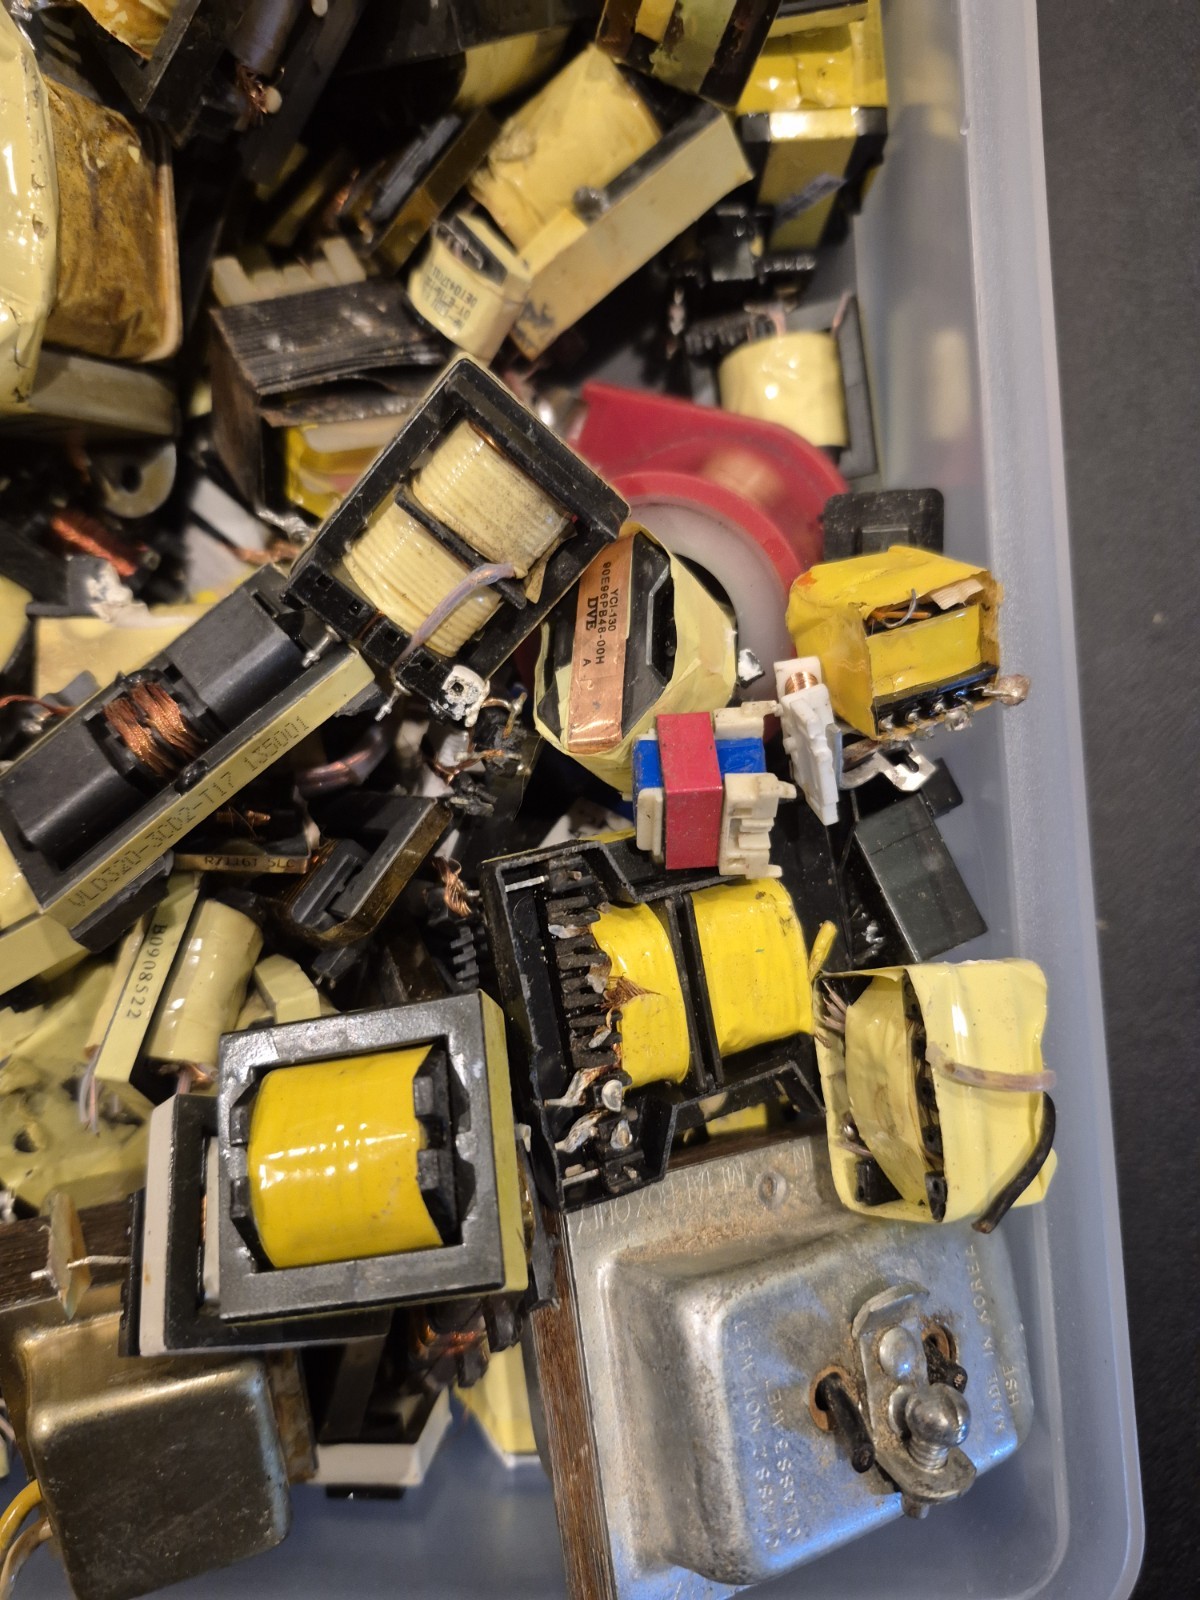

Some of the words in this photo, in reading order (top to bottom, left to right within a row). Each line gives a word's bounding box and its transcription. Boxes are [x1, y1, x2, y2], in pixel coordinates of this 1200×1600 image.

[586, 596, 599, 631] DVE
[608, 588, 619, 632] YCI-130
[583, 658, 592, 667] A
[244, 716, 310, 772] 135001
[126, 924, 168, 1019] B0908522
[744, 1387, 761, 1433] NOT
